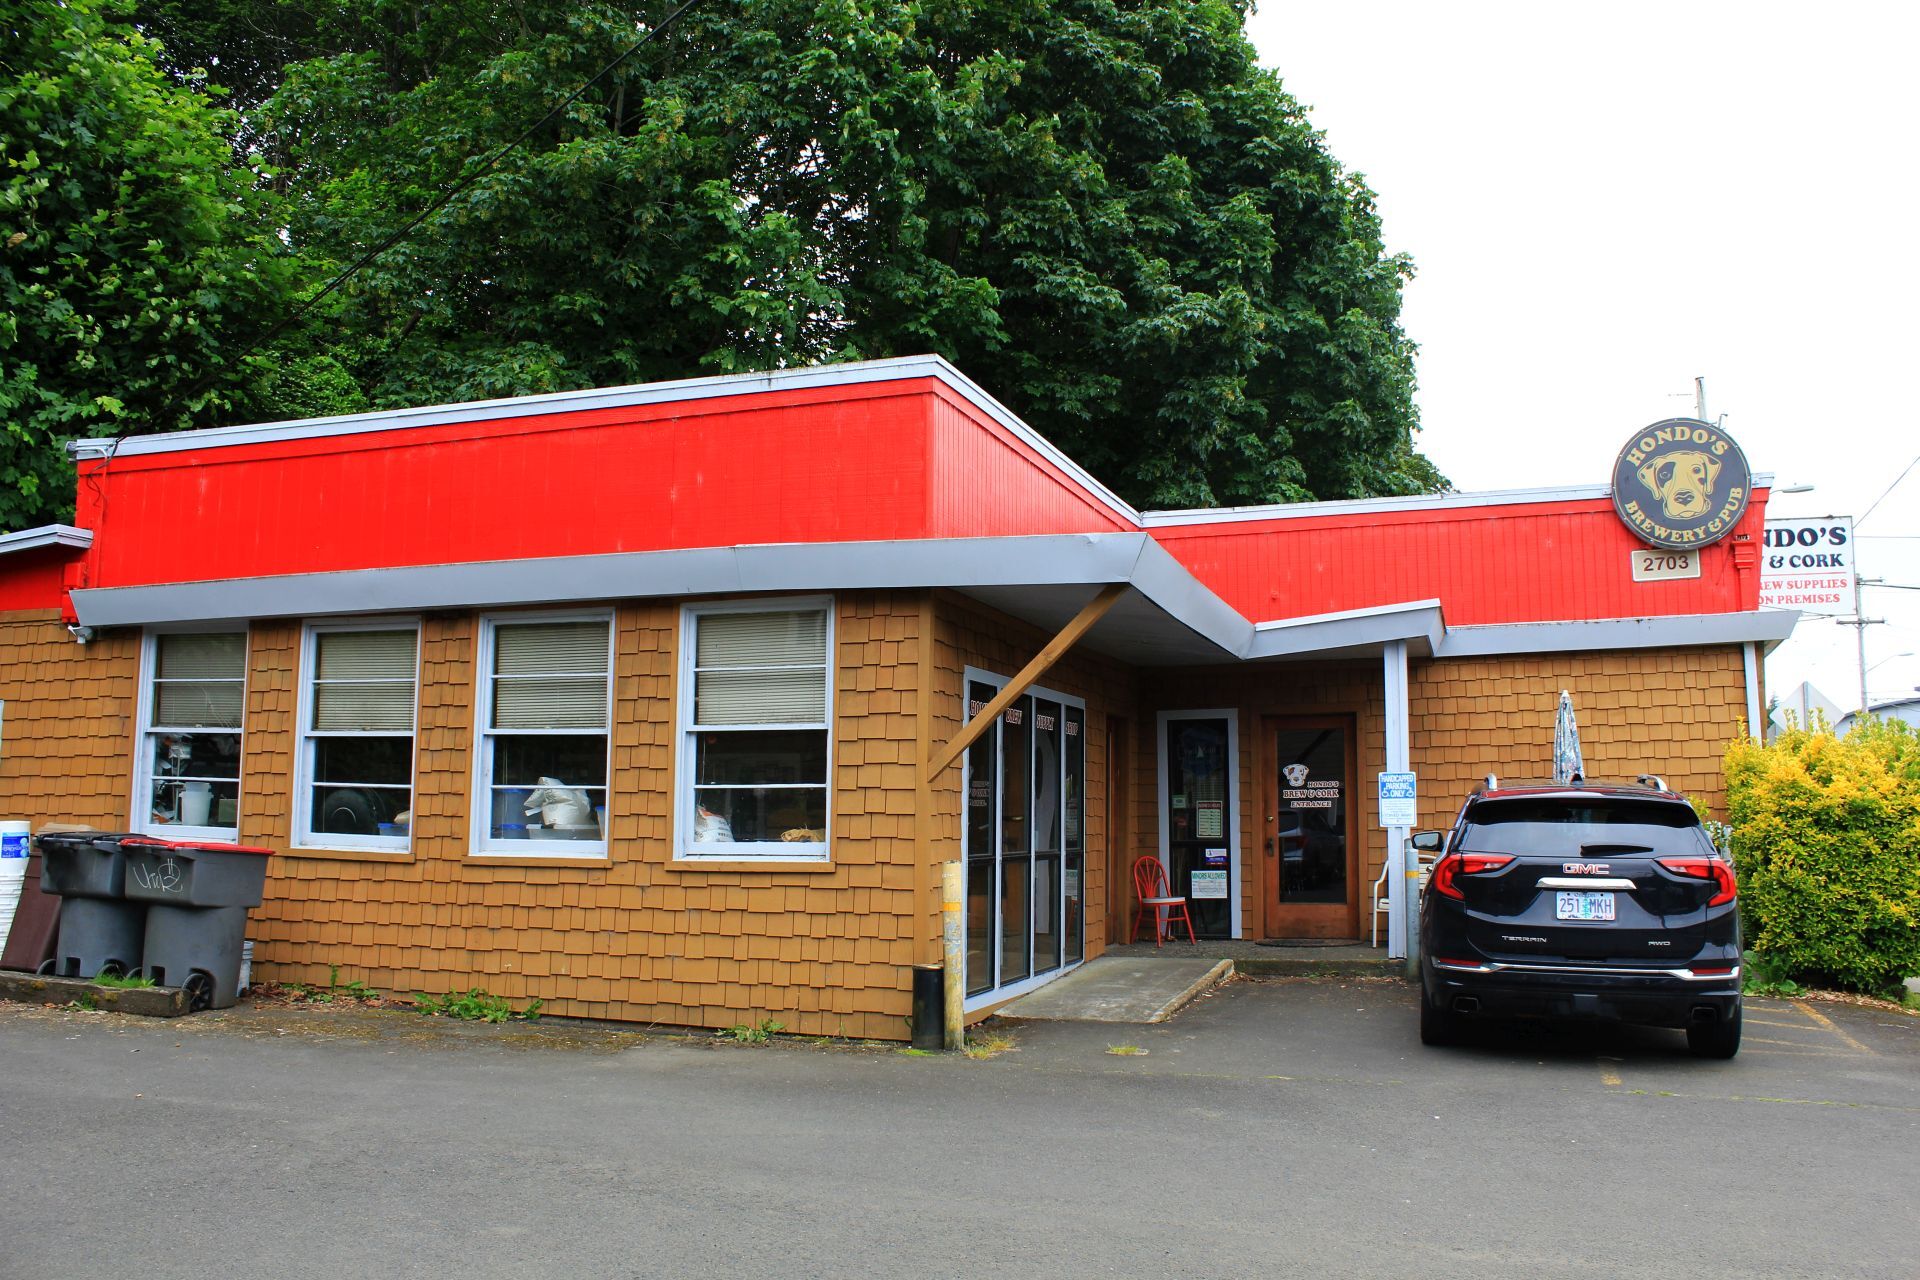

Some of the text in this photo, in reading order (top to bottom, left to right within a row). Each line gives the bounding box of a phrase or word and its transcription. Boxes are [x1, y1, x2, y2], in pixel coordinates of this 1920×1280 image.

[1626, 426, 1728, 467] HONDO'S
[1625, 487, 1743, 542] BREWERY & PUB
[1643, 555, 1689, 572] 2703
[1769, 553, 1845, 569] & CORK
[1787, 578, 1847, 590] SUPPLIES
[1777, 593, 1841, 605] PREMISES
[1307, 780, 1340, 788] HONDO'S
[1380, 773, 1414, 783] HANDICAPPED
[1385, 782, 1411, 790] PARKING
[1283, 789, 1307, 799] BREW
[1315, 788, 1340, 798] CORK
[1389, 789, 1406, 798] ONLY
[1290, 800, 1332, 808] ENTRANCE
[1563, 863, 1610, 875] GMC
[1559, 898, 1612, 914] 251 MKH
[1501, 935, 1548, 943] TERRAIN
